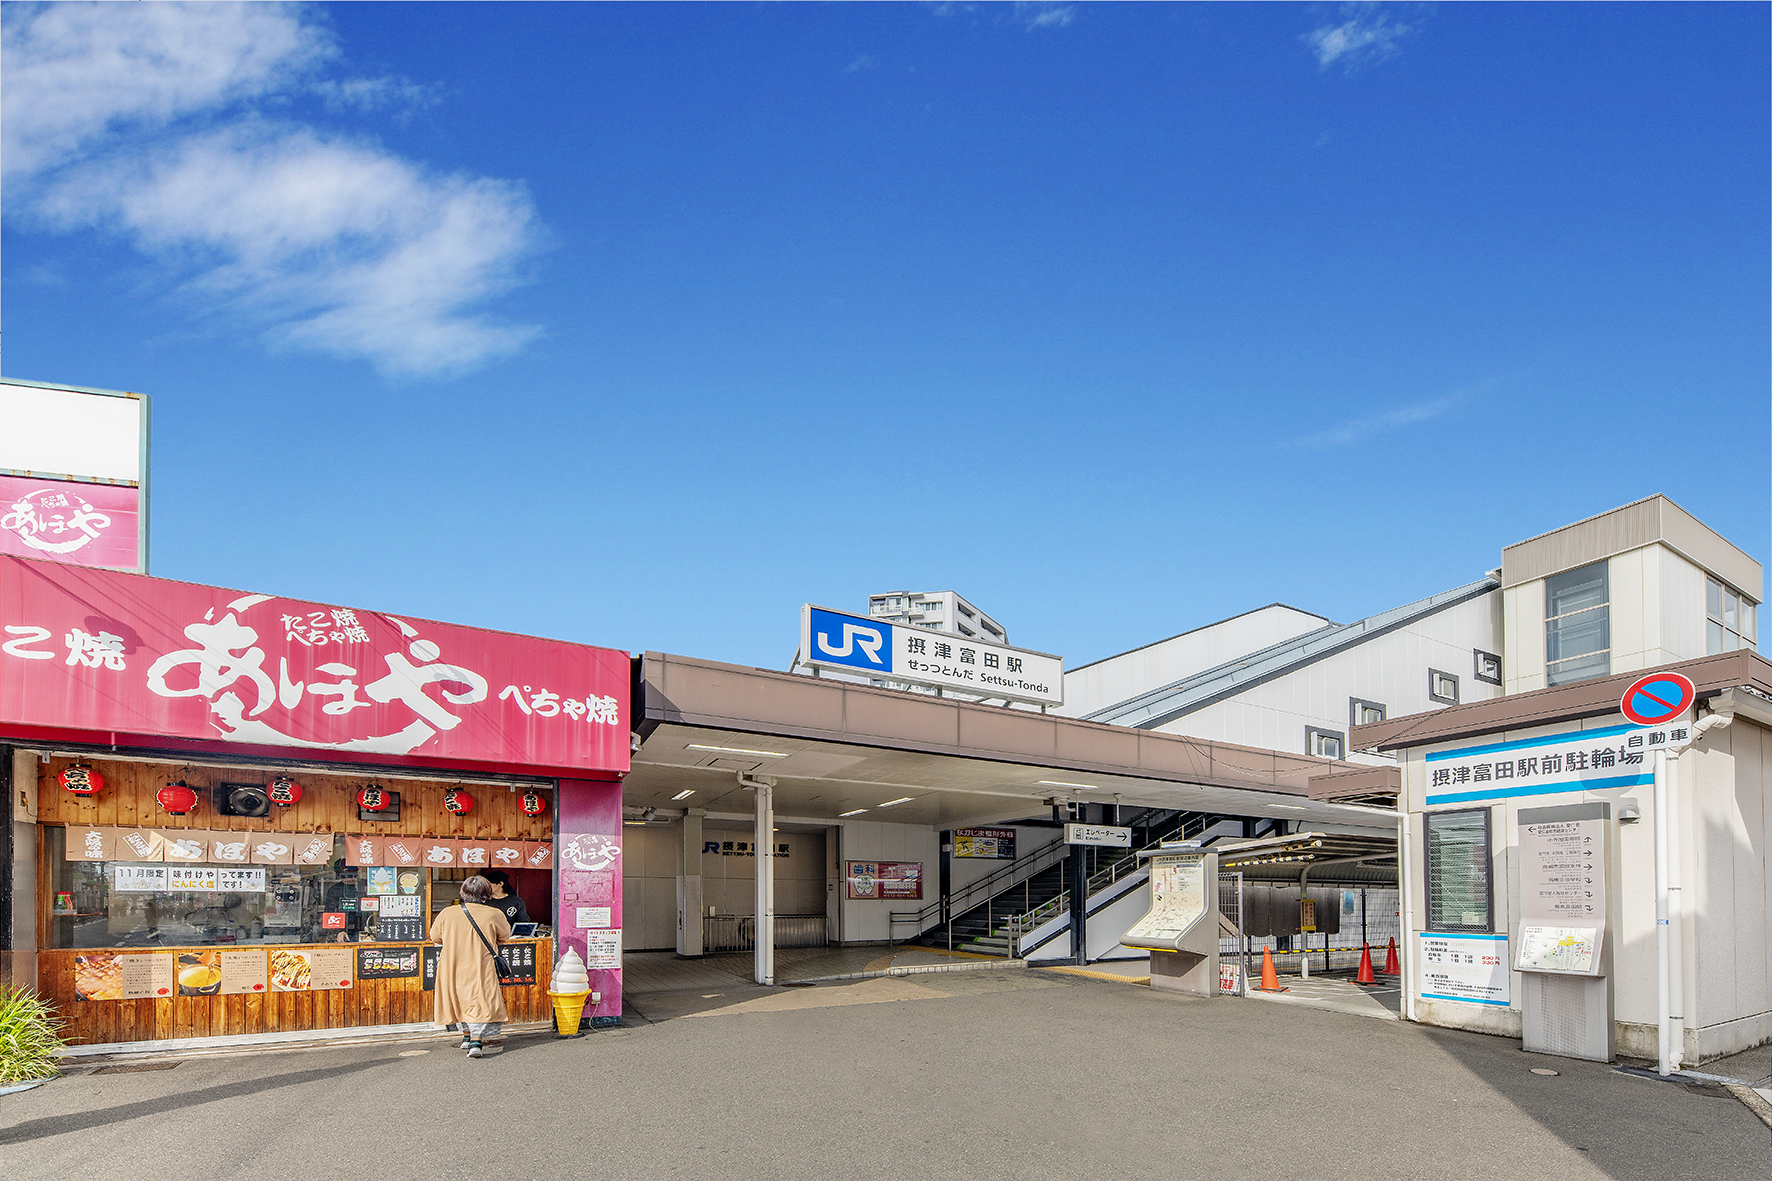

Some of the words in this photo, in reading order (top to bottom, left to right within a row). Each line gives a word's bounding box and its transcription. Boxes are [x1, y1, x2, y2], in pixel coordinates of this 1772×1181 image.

[1, 499, 111, 539] あほや
[280, 608, 359, 630] たこ焼
[286, 625, 371, 647] ぺちゃ焼
[817, 622, 884, 664] JR
[907, 636, 1023, 674] 摂津富田駅
[147, 611, 488, 730] あほや
[907, 659, 974, 681] せっつとんだ
[980, 672, 1049, 694] Settsu-Tonda
[498, 684, 620, 726] ぺちゃ焼
[1628, 728, 1689, 749] 自動車
[1432, 745, 1644, 787] 摂津富田駅前駐輪場
[1085, 829, 1115, 837] エレベーター
[561, 840, 621, 861] あほや
[722, 841, 789, 853] 摂津駅
[854, 863, 876, 875] 歯科
[172, 880, 215, 889] にんにく塩
